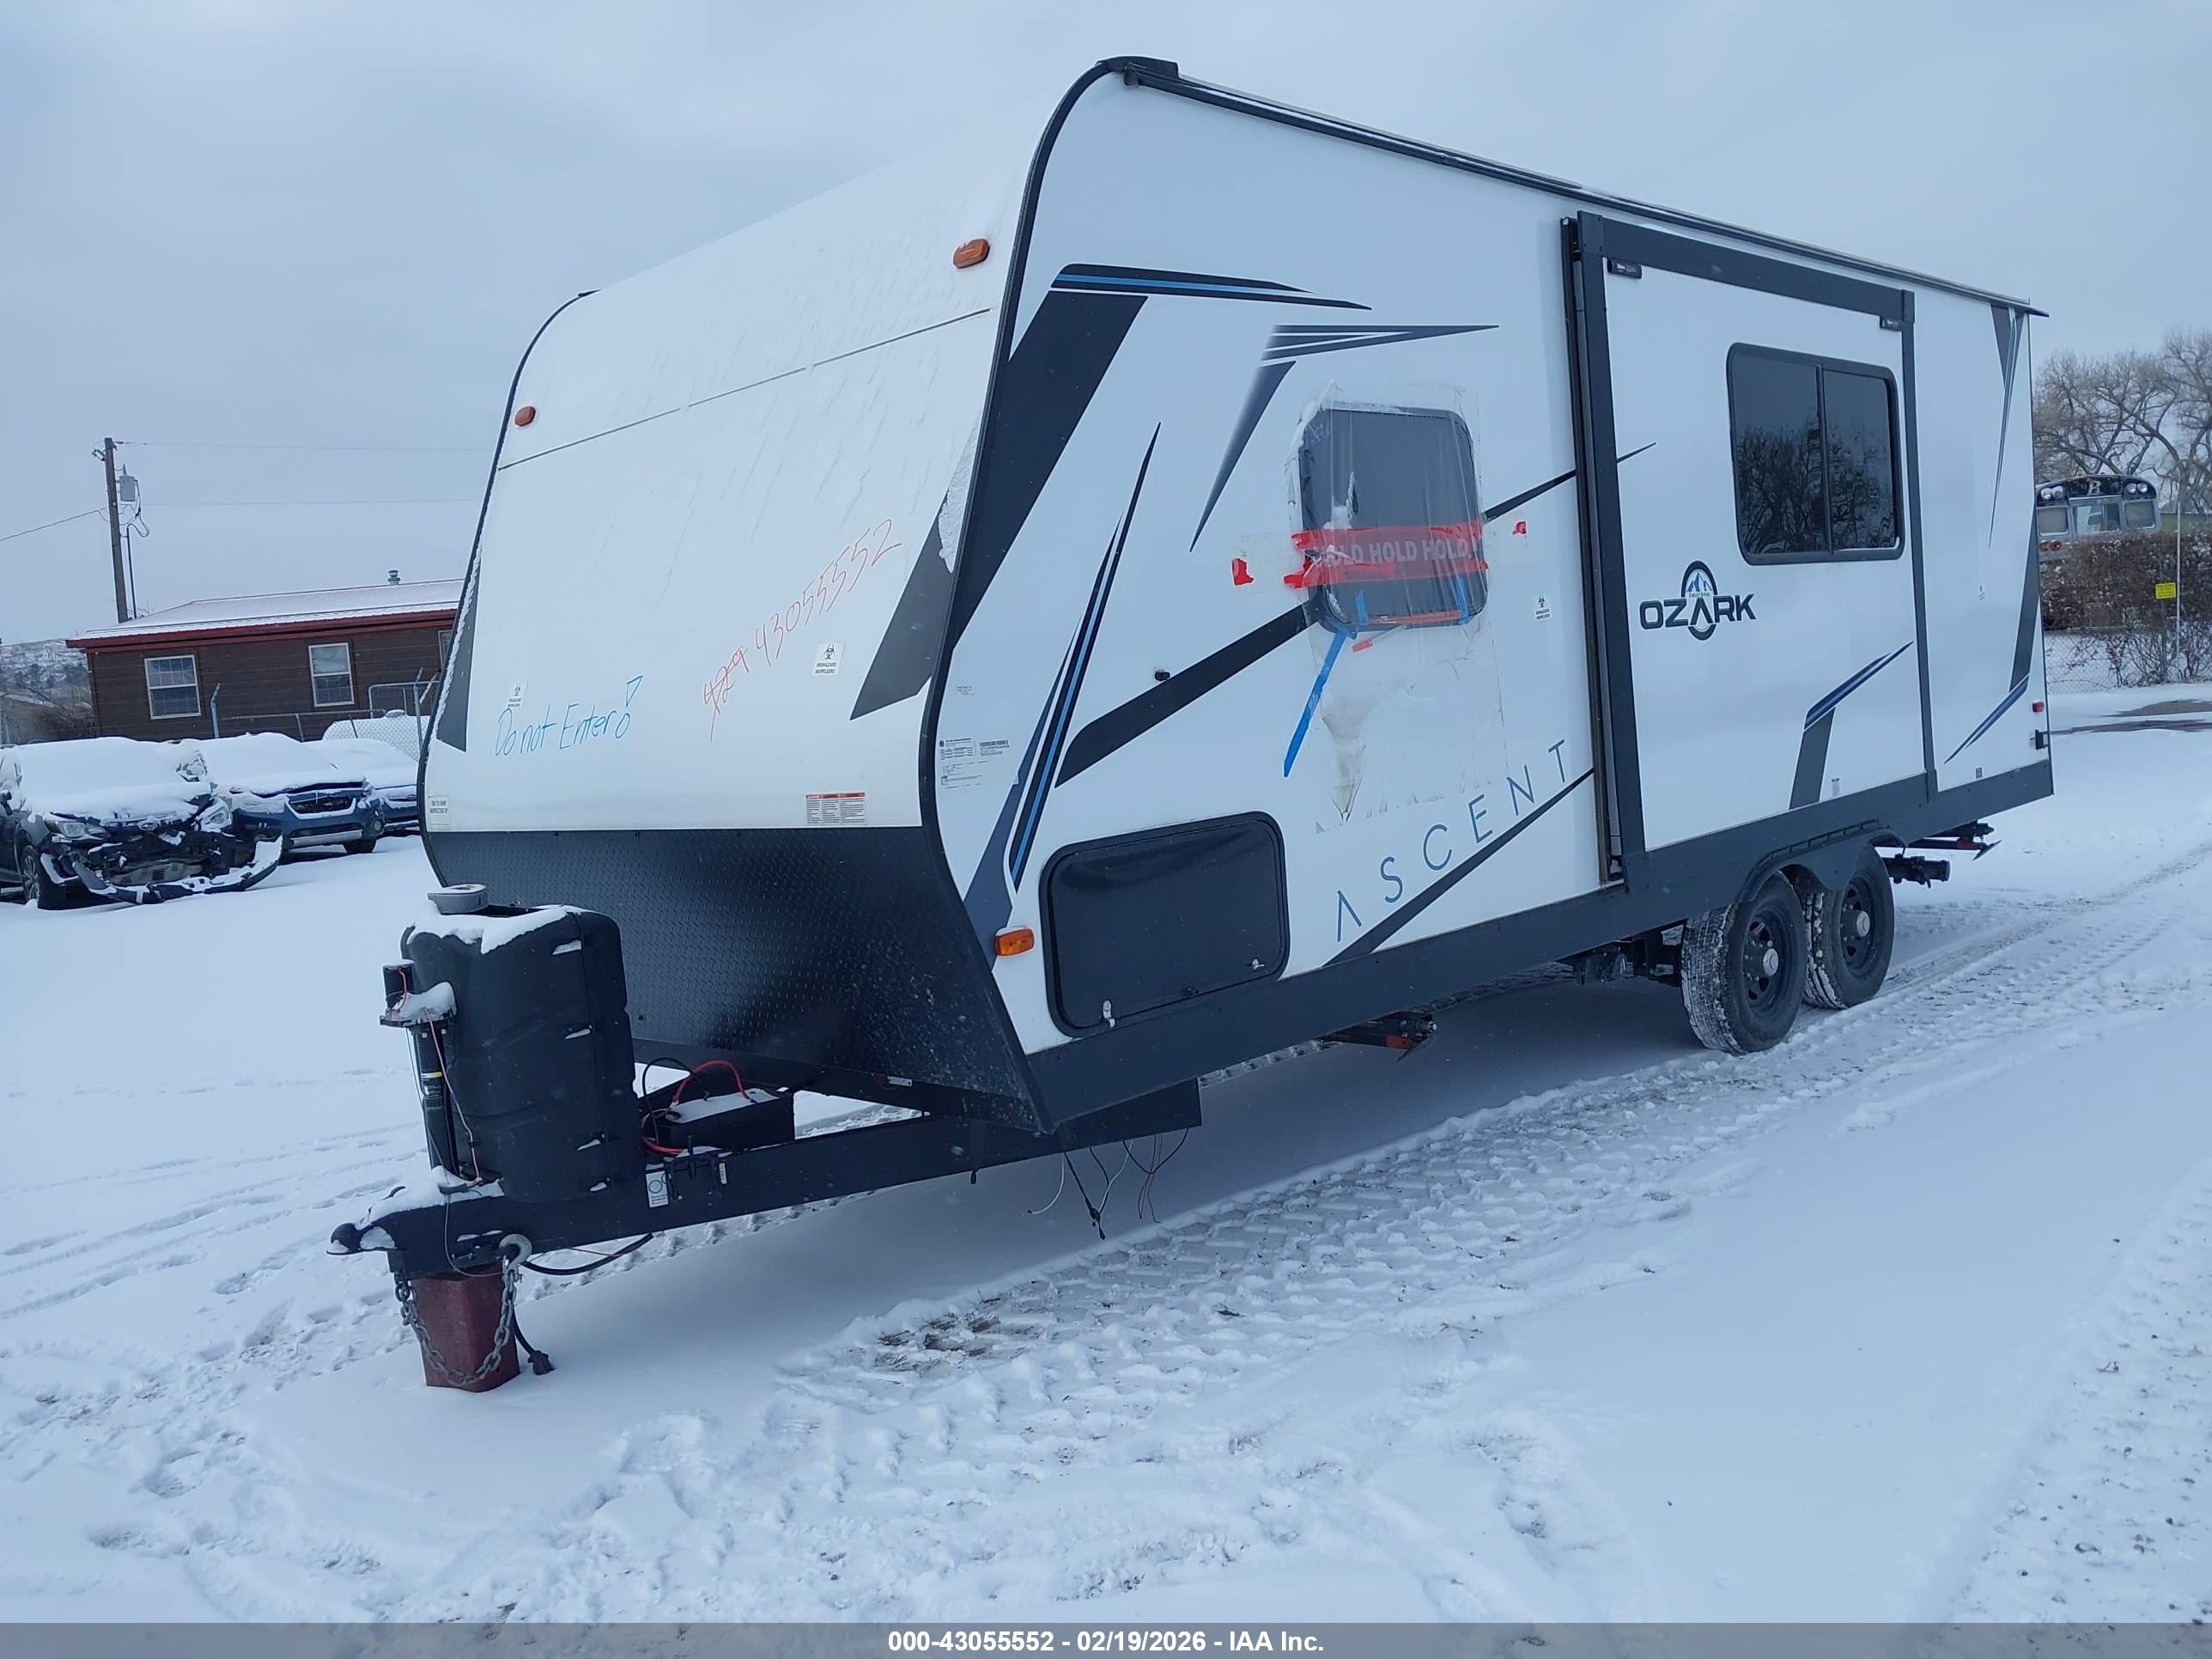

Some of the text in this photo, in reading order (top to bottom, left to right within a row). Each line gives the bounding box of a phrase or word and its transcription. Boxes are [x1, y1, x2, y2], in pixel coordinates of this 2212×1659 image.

[1369, 539, 1417, 565] HOLD
[1421, 538, 1468, 561] HOLD
[754, 518, 902, 667] 43055552
[1639, 593, 1757, 630] OZARK
[495, 708, 517, 757] Do
[520, 704, 557, 754] not
[1336, 738, 1565, 943] ASCENT
